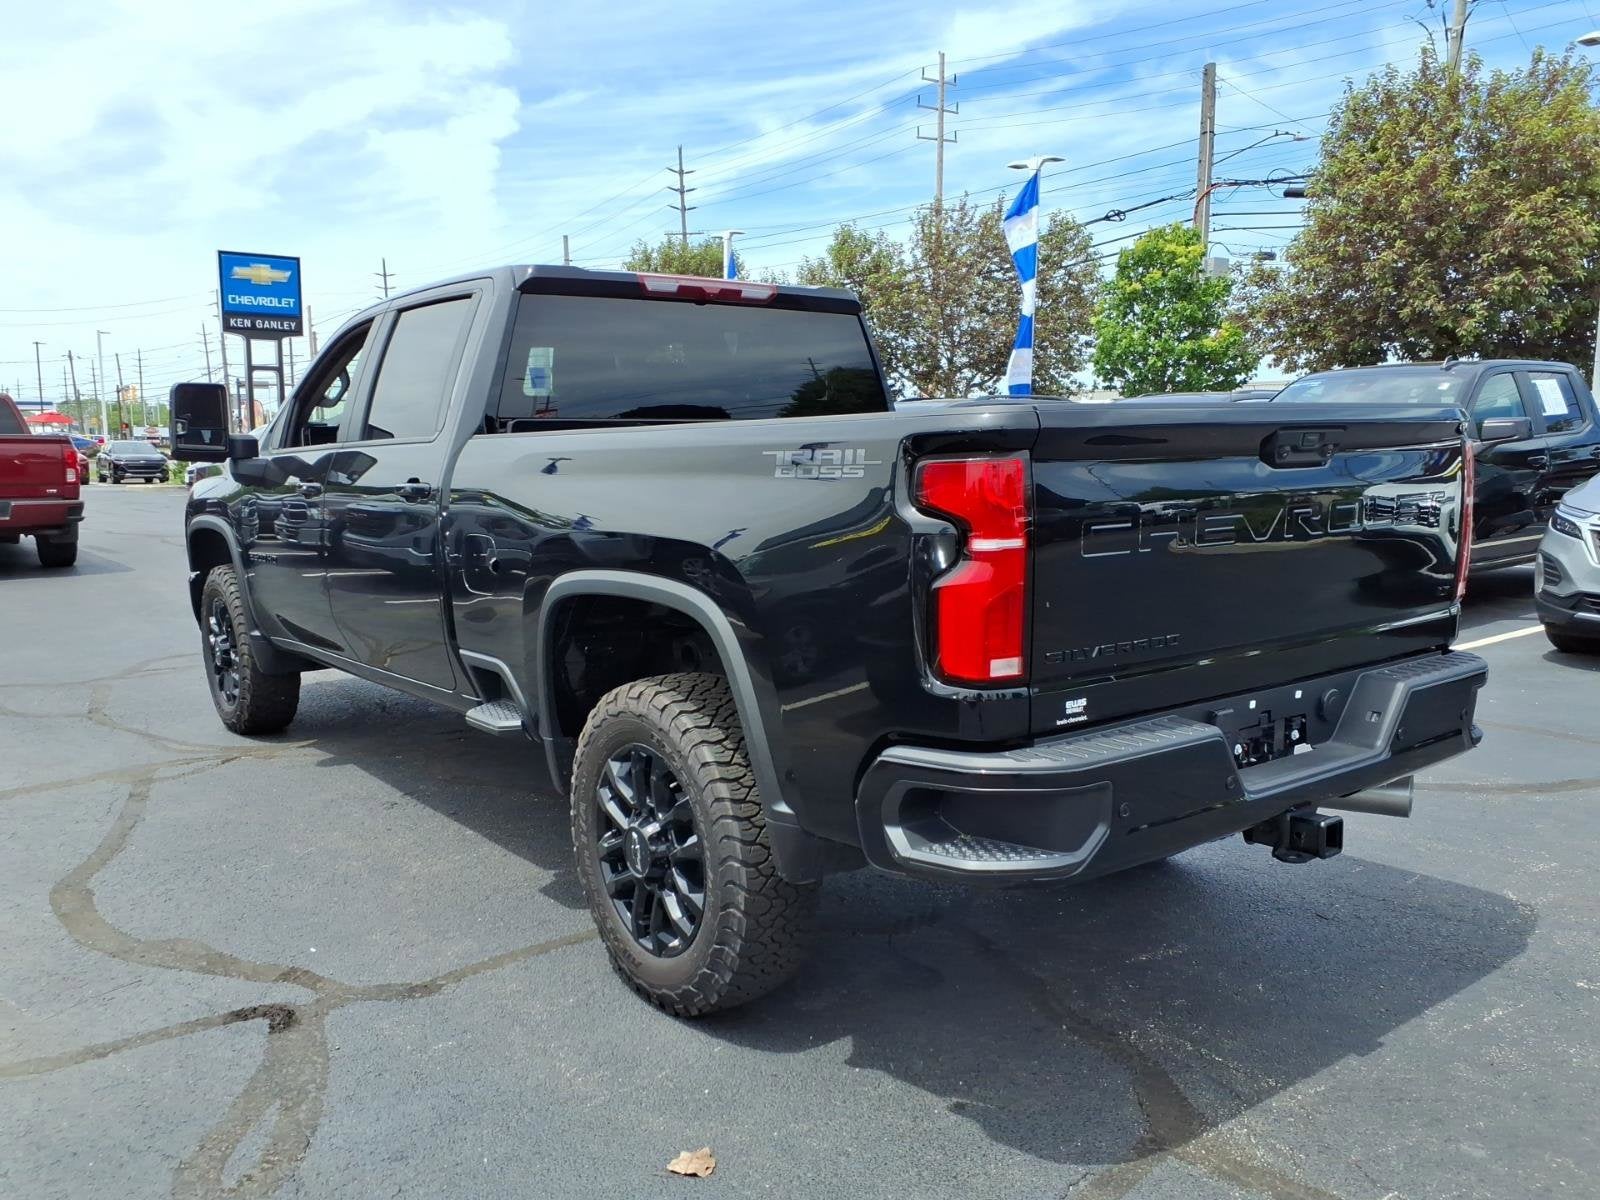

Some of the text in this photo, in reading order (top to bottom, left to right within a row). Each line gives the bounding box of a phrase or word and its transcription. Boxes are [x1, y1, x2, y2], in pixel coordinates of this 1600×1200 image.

[228, 294, 295, 307] CHEVROLET
[230, 318, 297, 330] KEN GANLEY
